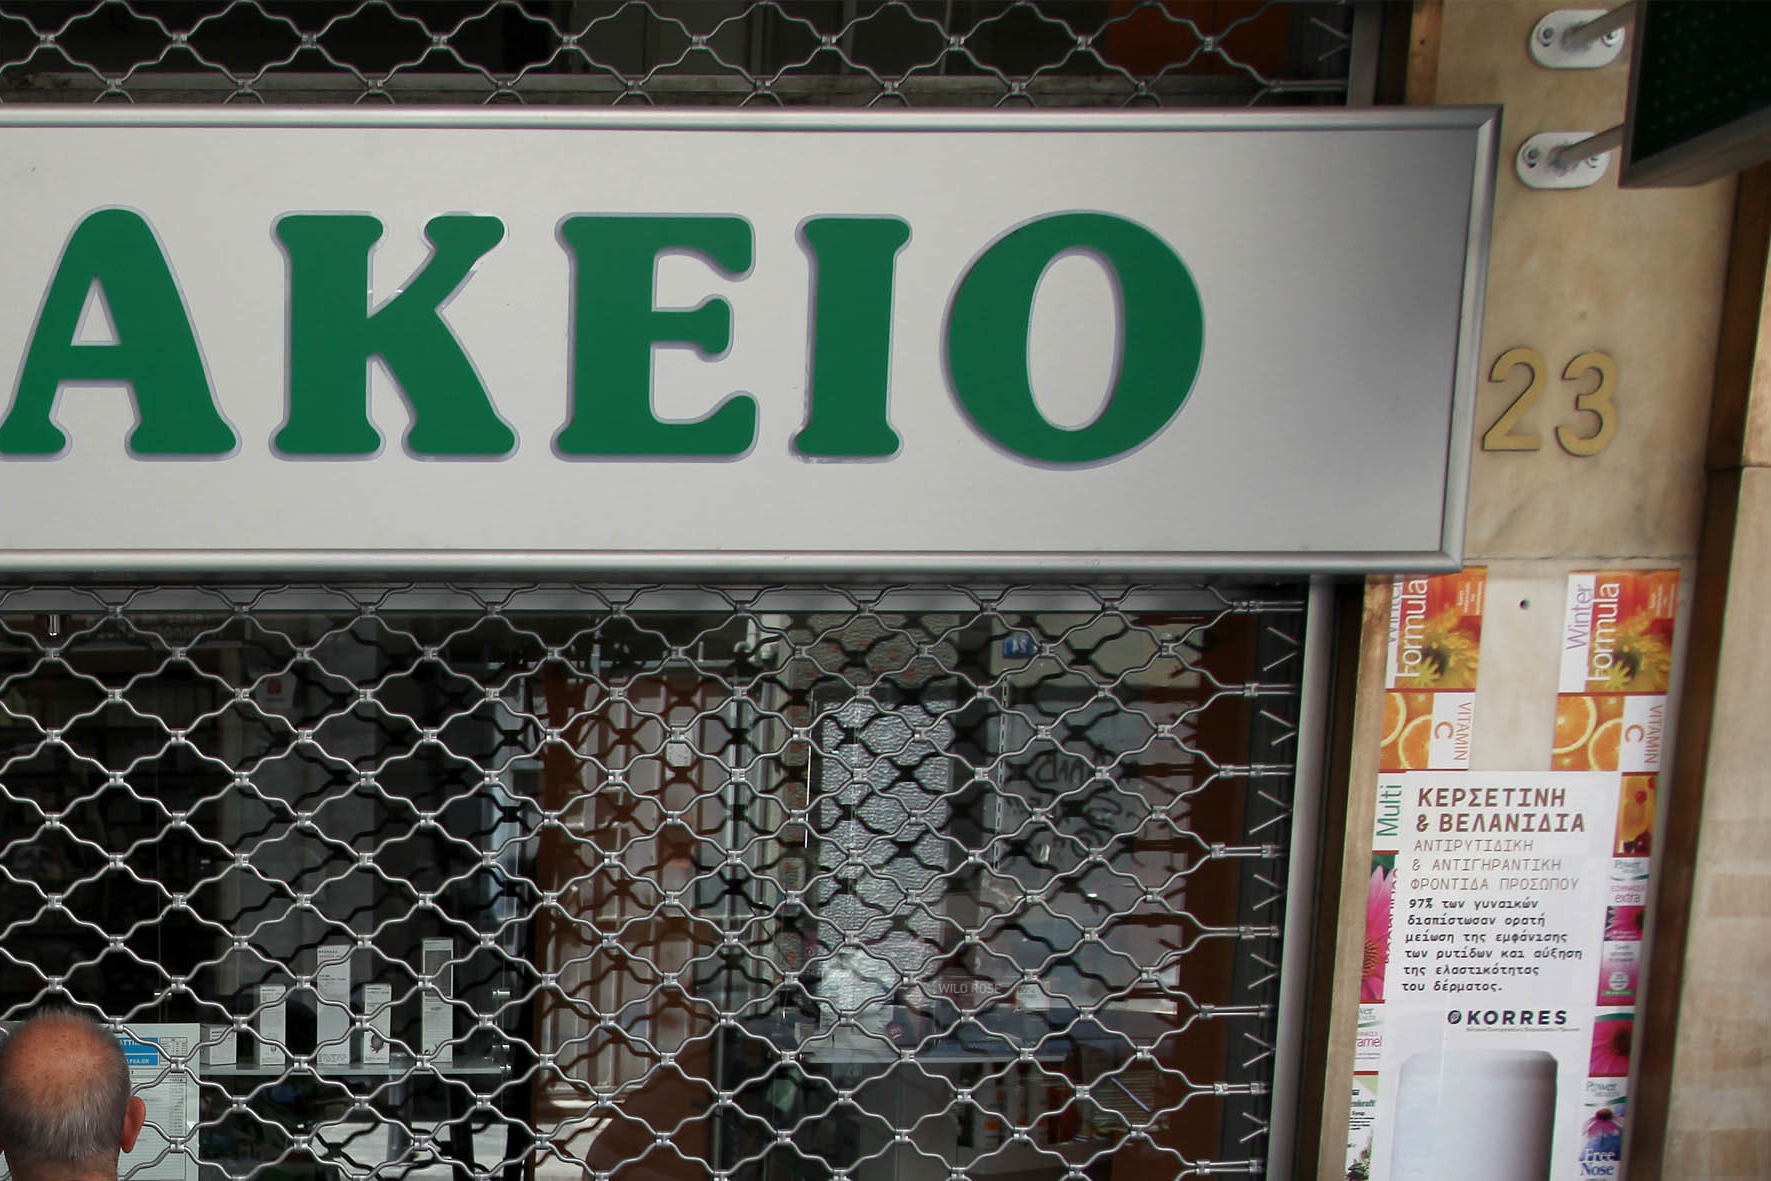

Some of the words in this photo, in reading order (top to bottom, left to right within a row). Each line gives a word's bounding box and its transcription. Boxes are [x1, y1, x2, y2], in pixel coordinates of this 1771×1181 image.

[1482, 347, 1619, 456] 23
[1566, 584, 1593, 650] Winter
[1394, 579, 1429, 678] Formula
[1586, 583, 1621, 681] Formula
[1434, 721, 1454, 740] C
[1453, 702, 1472, 761] VITAMIN
[1625, 724, 1644, 743] C
[1644, 705, 1663, 764] VITAMIN
[1417, 787, 1566, 807] ΚΕΡΣΕΤΙΝΗ
[1376, 785, 1402, 836] Multi
[1416, 814, 1430, 832] &
[1439, 813, 1585, 832] ΒΕΛΑΝΙΔΙΑ
[1414, 839, 1533, 852] ΑΝΤΙΡΥΤΙΔΙΚΗ
[1412, 859, 1421, 871] &
[1432, 859, 1561, 871] ΑΝΤΙΓΗΡΑΝΤΙΚΗ
[1411, 878, 1489, 890] ΦΡΟΝΤΙΔΑ
[1499, 878, 1579, 891] ΠΡΟΣΩΠΟΥ
[1409, 898, 1433, 909] 97%
[1441, 901, 1465, 909] των
[1474, 897, 1539, 912] γυναικών
[1407, 914, 1496, 926] διαπίστωσαν
[1504, 913, 1546, 927] ορατή
[1405, 931, 1455, 943] μείωση
[1463, 934, 1486, 943] της
[1495, 930, 1568, 943] εμφάνισης
[1405, 950, 1428, 958] των
[1436, 947, 1493, 959] ρυτίδων
[1501, 950, 1525, 958] και
[1534, 947, 1583, 960] αύξηση
[1404, 966, 1426, 976] της
[1435, 962, 1540, 975] ελαστικότητας
[938, 983, 968, 994] WILD
[1402, 982, 1425, 991] του
[1433, 978, 1503, 993] δέρματος.
[1467, 1010, 1567, 1025] KORRES
[1581, 1162, 1614, 1176] Nose
